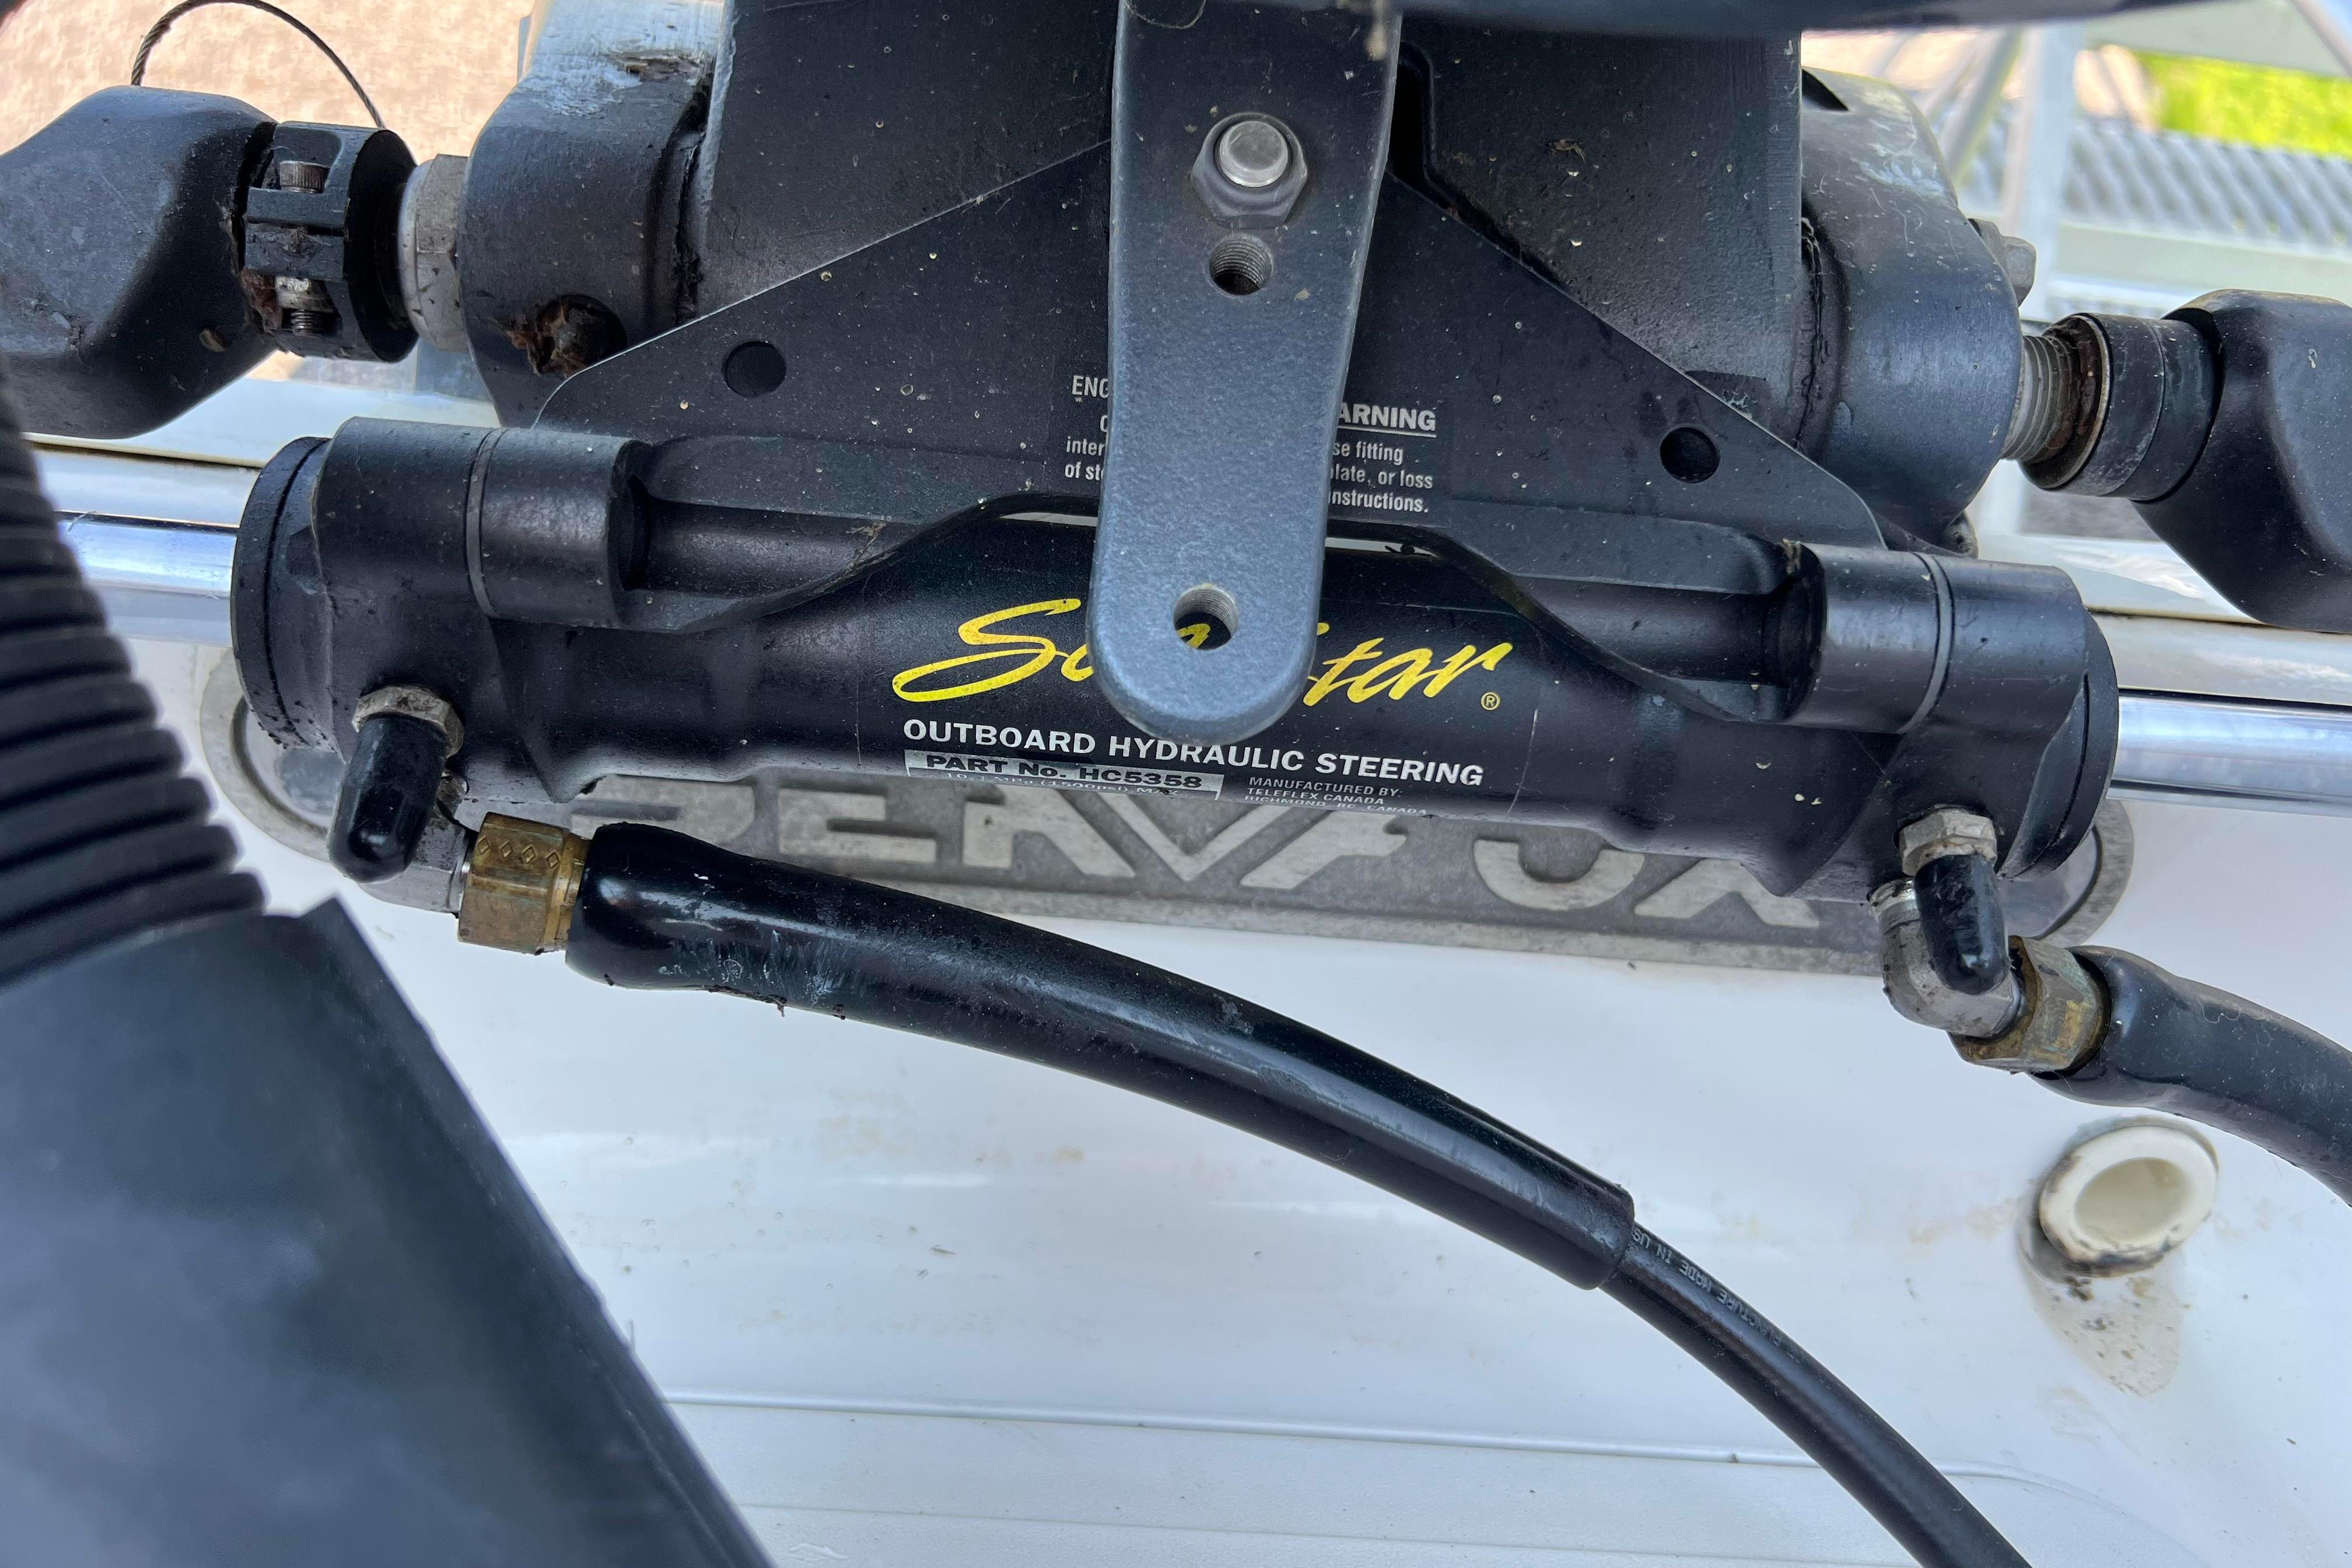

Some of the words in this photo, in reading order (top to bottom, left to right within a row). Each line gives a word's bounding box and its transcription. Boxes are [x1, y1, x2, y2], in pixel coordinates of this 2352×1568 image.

[1338, 402, 1437, 432] ARNING
[1355, 440, 1404, 466] fitting
[1064, 461, 1082, 479] of
[1378, 471, 1396, 486] or
[1400, 470, 1433, 489] loss
[903, 719, 1096, 754] OUTBOARD
[1108, 736, 1304, 771] HYDRAULIC
[1314, 752, 1485, 787] STEERING
[926, 755, 1008, 773] PART
[1019, 762, 1066, 778] No.
[1079, 767, 1202, 788] HC5358
[1247, 788, 1319, 800] TELEFLEX
[1323, 794, 1384, 805] CANADA
[1248, 777, 1374, 796] MANUFACTURED
[1366, 805, 1427, 814] CANADA
[1656, 1243, 1673, 1264] IN
[1678, 1259, 1713, 1292] MADE
